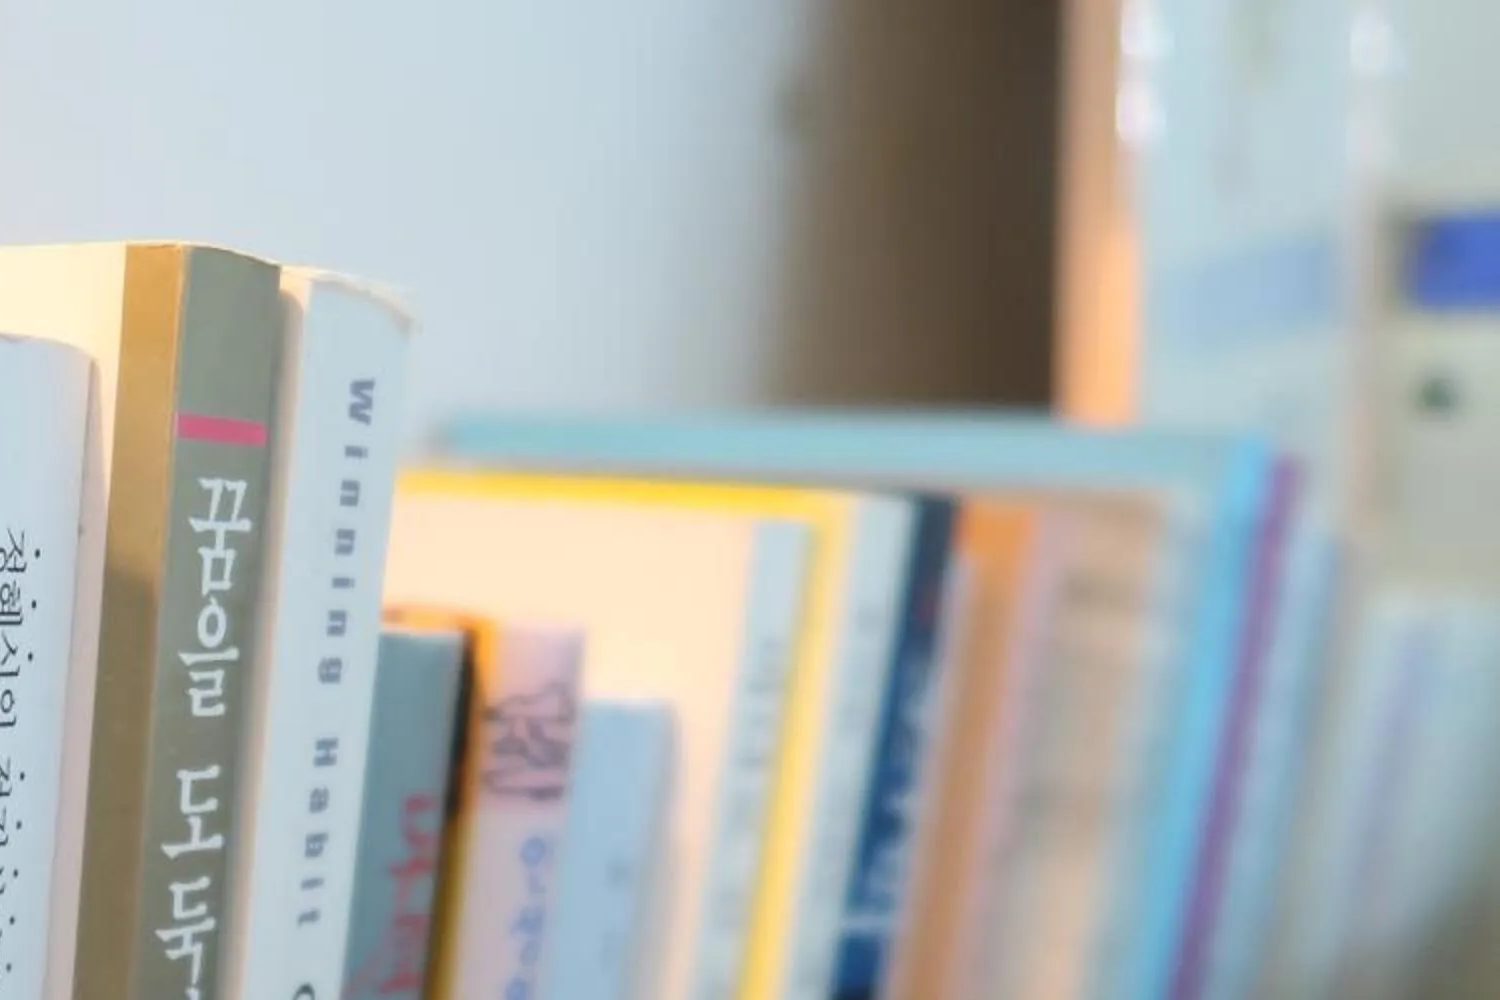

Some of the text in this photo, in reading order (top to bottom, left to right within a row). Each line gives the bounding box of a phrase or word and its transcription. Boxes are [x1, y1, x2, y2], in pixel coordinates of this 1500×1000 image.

[178, 478, 252, 717] 꿈을
[297, 378, 375, 926] Winning Habit
